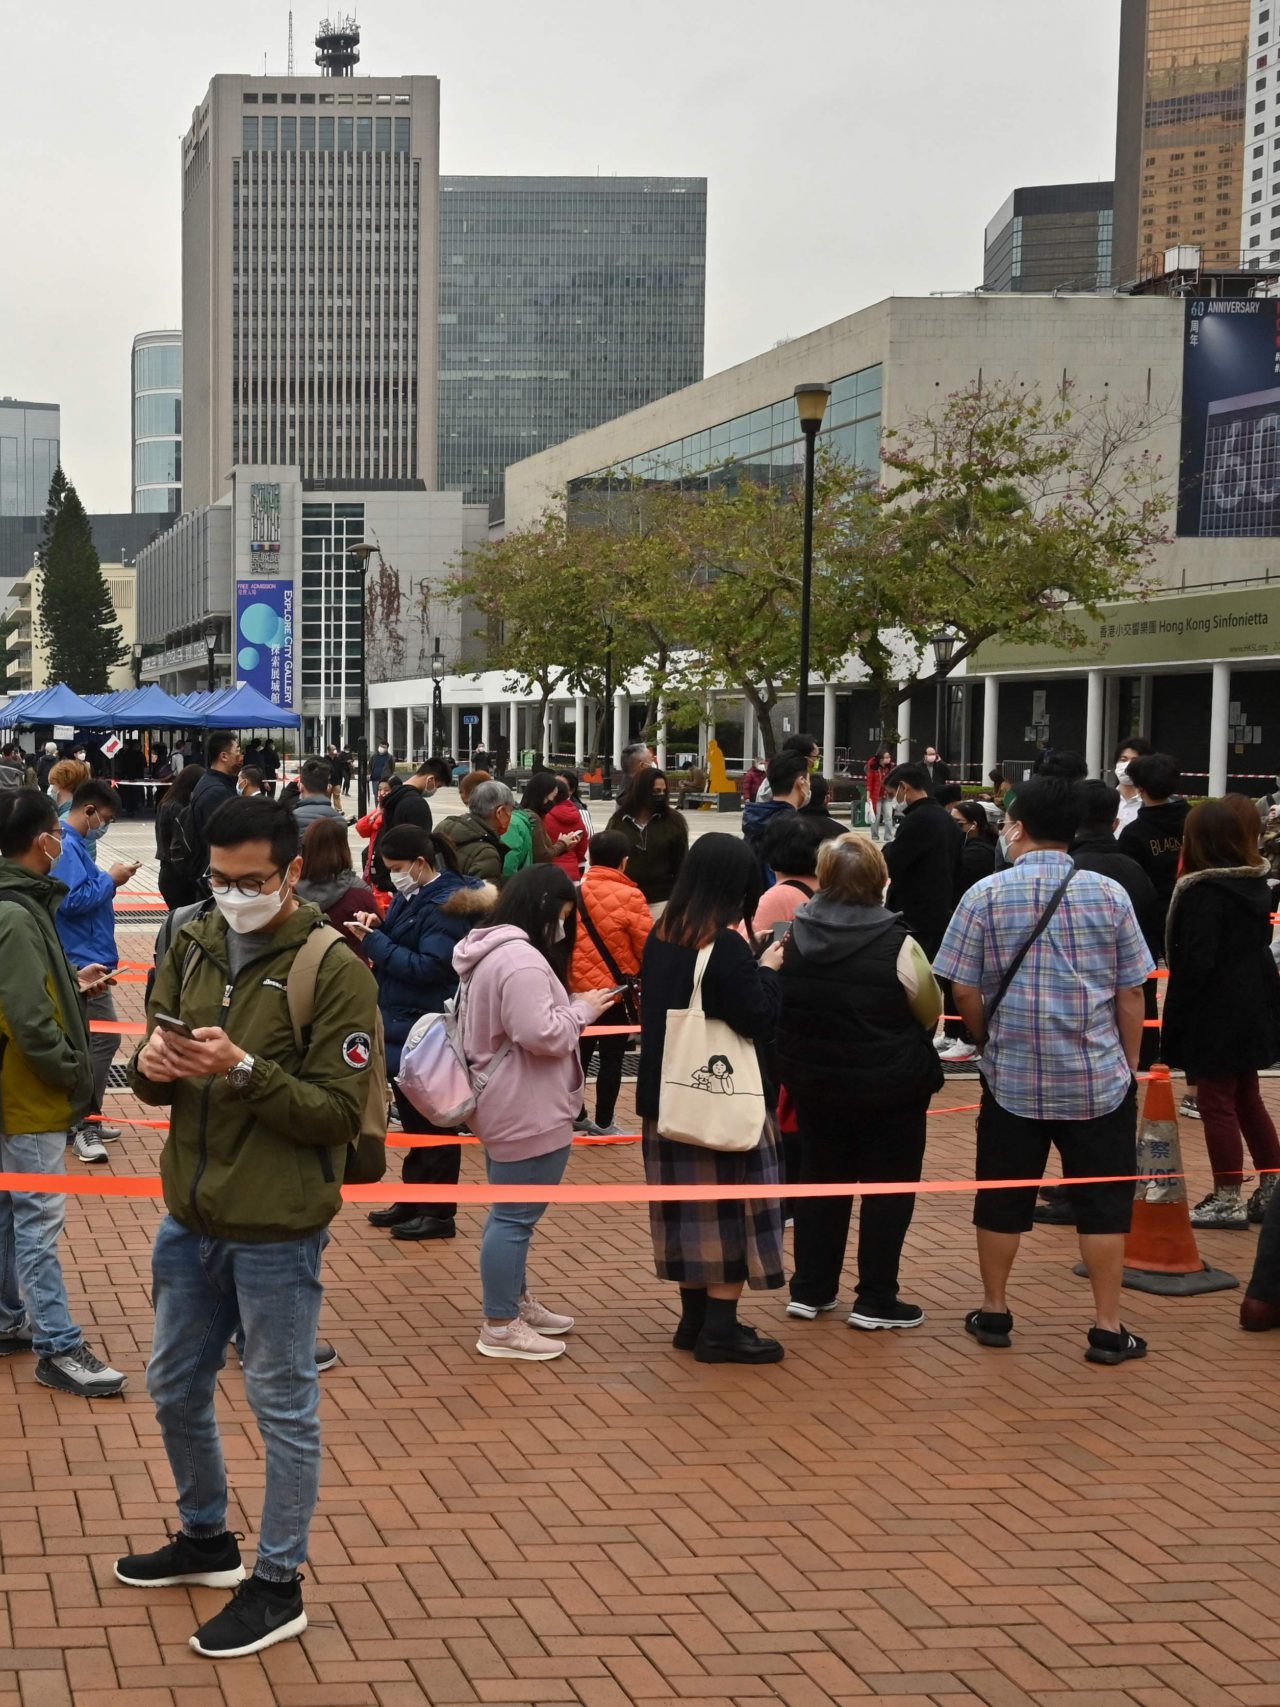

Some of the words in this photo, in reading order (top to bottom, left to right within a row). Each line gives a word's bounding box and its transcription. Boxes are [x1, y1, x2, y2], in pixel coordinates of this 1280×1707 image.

[1191, 301, 1204, 316] 60
[1207, 301, 1260, 313] ANNIVERSARY
[1190, 320, 1199, 348] 周年
[284, 590, 293, 634] EXPLORE
[1100, 620, 1157, 638] 香港小交響樂團
[1159, 620, 1184, 635] Hong
[1186, 617, 1211, 633] Kong
[1213, 612, 1268, 629] Sinfonietta
[284, 636, 293, 659] CITY
[271, 643, 280, 704] 探索展城館
[284, 660, 293, 704] GALLERY
